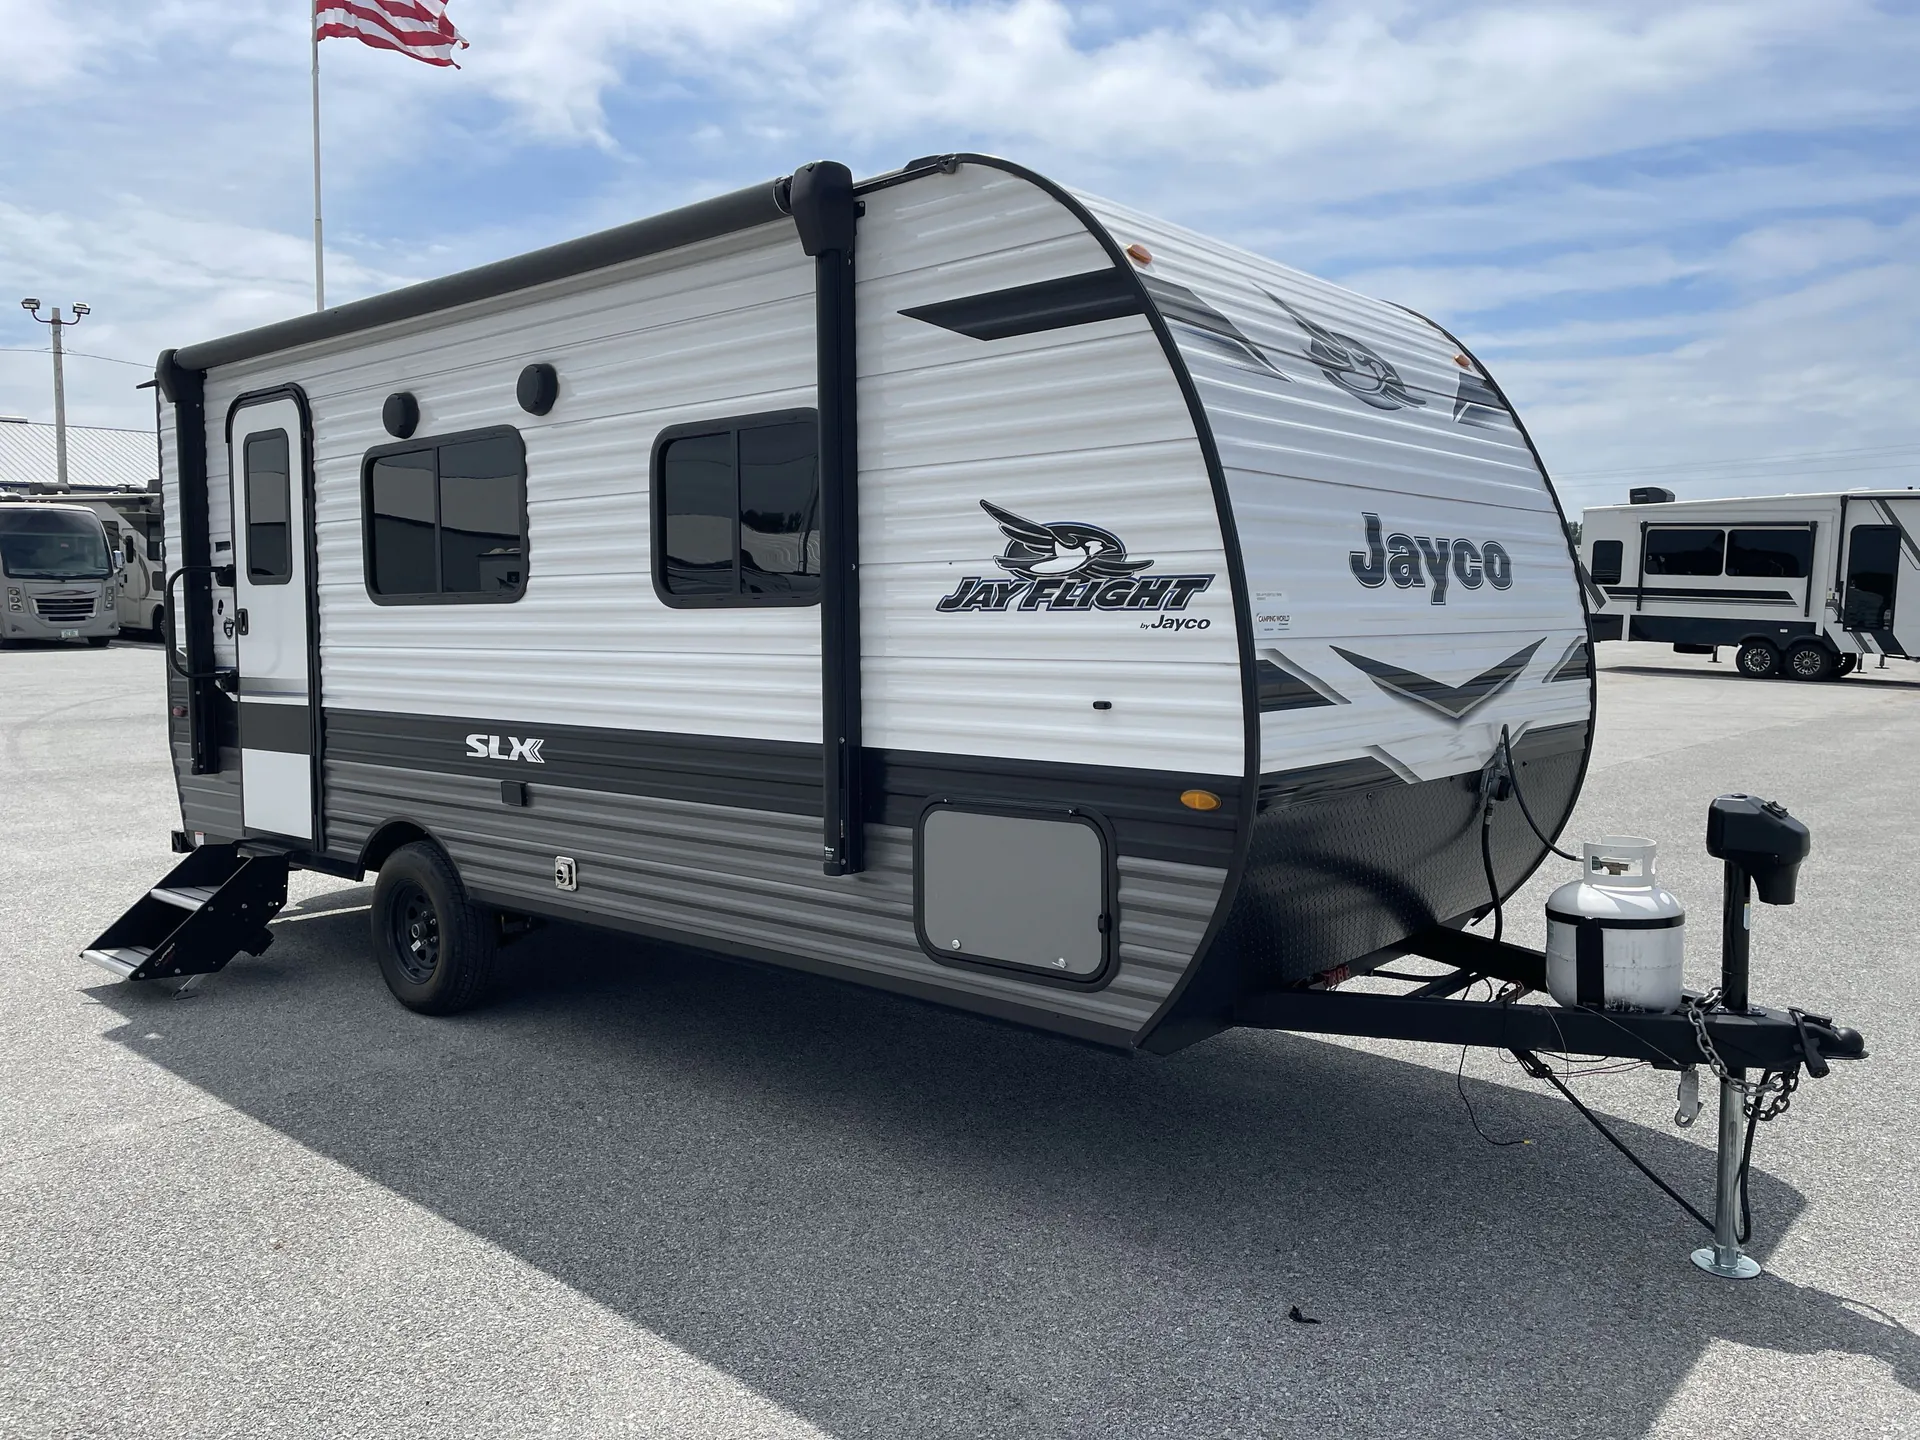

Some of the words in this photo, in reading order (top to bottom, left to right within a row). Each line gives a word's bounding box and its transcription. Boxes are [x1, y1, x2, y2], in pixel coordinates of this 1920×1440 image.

[1349, 511, 1513, 605] Jayco
[935, 576, 1033, 613] JAY
[1017, 574, 1216, 612] FLIGHT
[1140, 622, 1150, 630] by
[1151, 614, 1211, 631] Jayco
[465, 733, 546, 764] SLX
